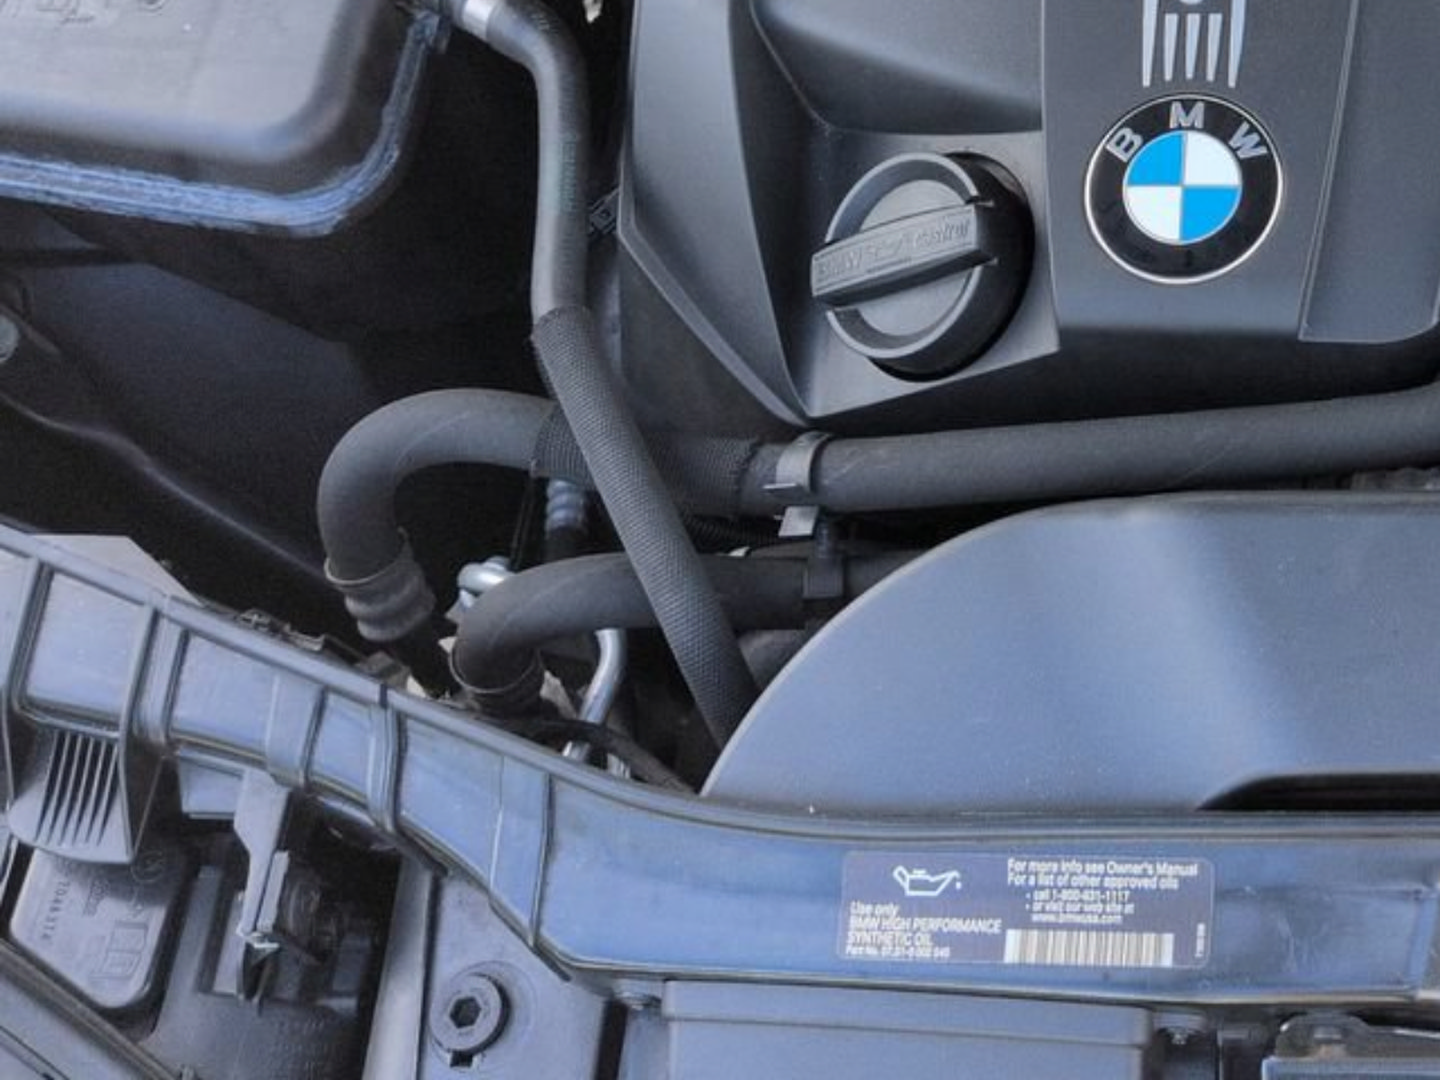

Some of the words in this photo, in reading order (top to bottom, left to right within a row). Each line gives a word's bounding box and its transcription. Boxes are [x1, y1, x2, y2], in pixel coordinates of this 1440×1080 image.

[1105, 101, 1268, 163] BMW
[1007, 859, 1026, 873] For
[1028, 861, 1058, 874] more
[1061, 860, 1082, 874] info
[1085, 862, 1105, 874] see
[1107, 861, 1153, 875] Owner's
[1156, 862, 1198, 876] Manual
[1007, 873, 1026, 885] For
[1057, 874, 1069, 886] of
[1071, 874, 1101, 887] other
[1103, 876, 1157, 889] approved
[850, 901, 872, 915] Use
[874, 902, 899, 917] only
[849, 915, 879, 930] BMW
[881, 916, 911, 931] HIGH
[912, 917, 1002, 934] PERFORMANCE
[847, 931, 912, 946] SYNTHETIC
[914, 931, 934, 946] OIL
